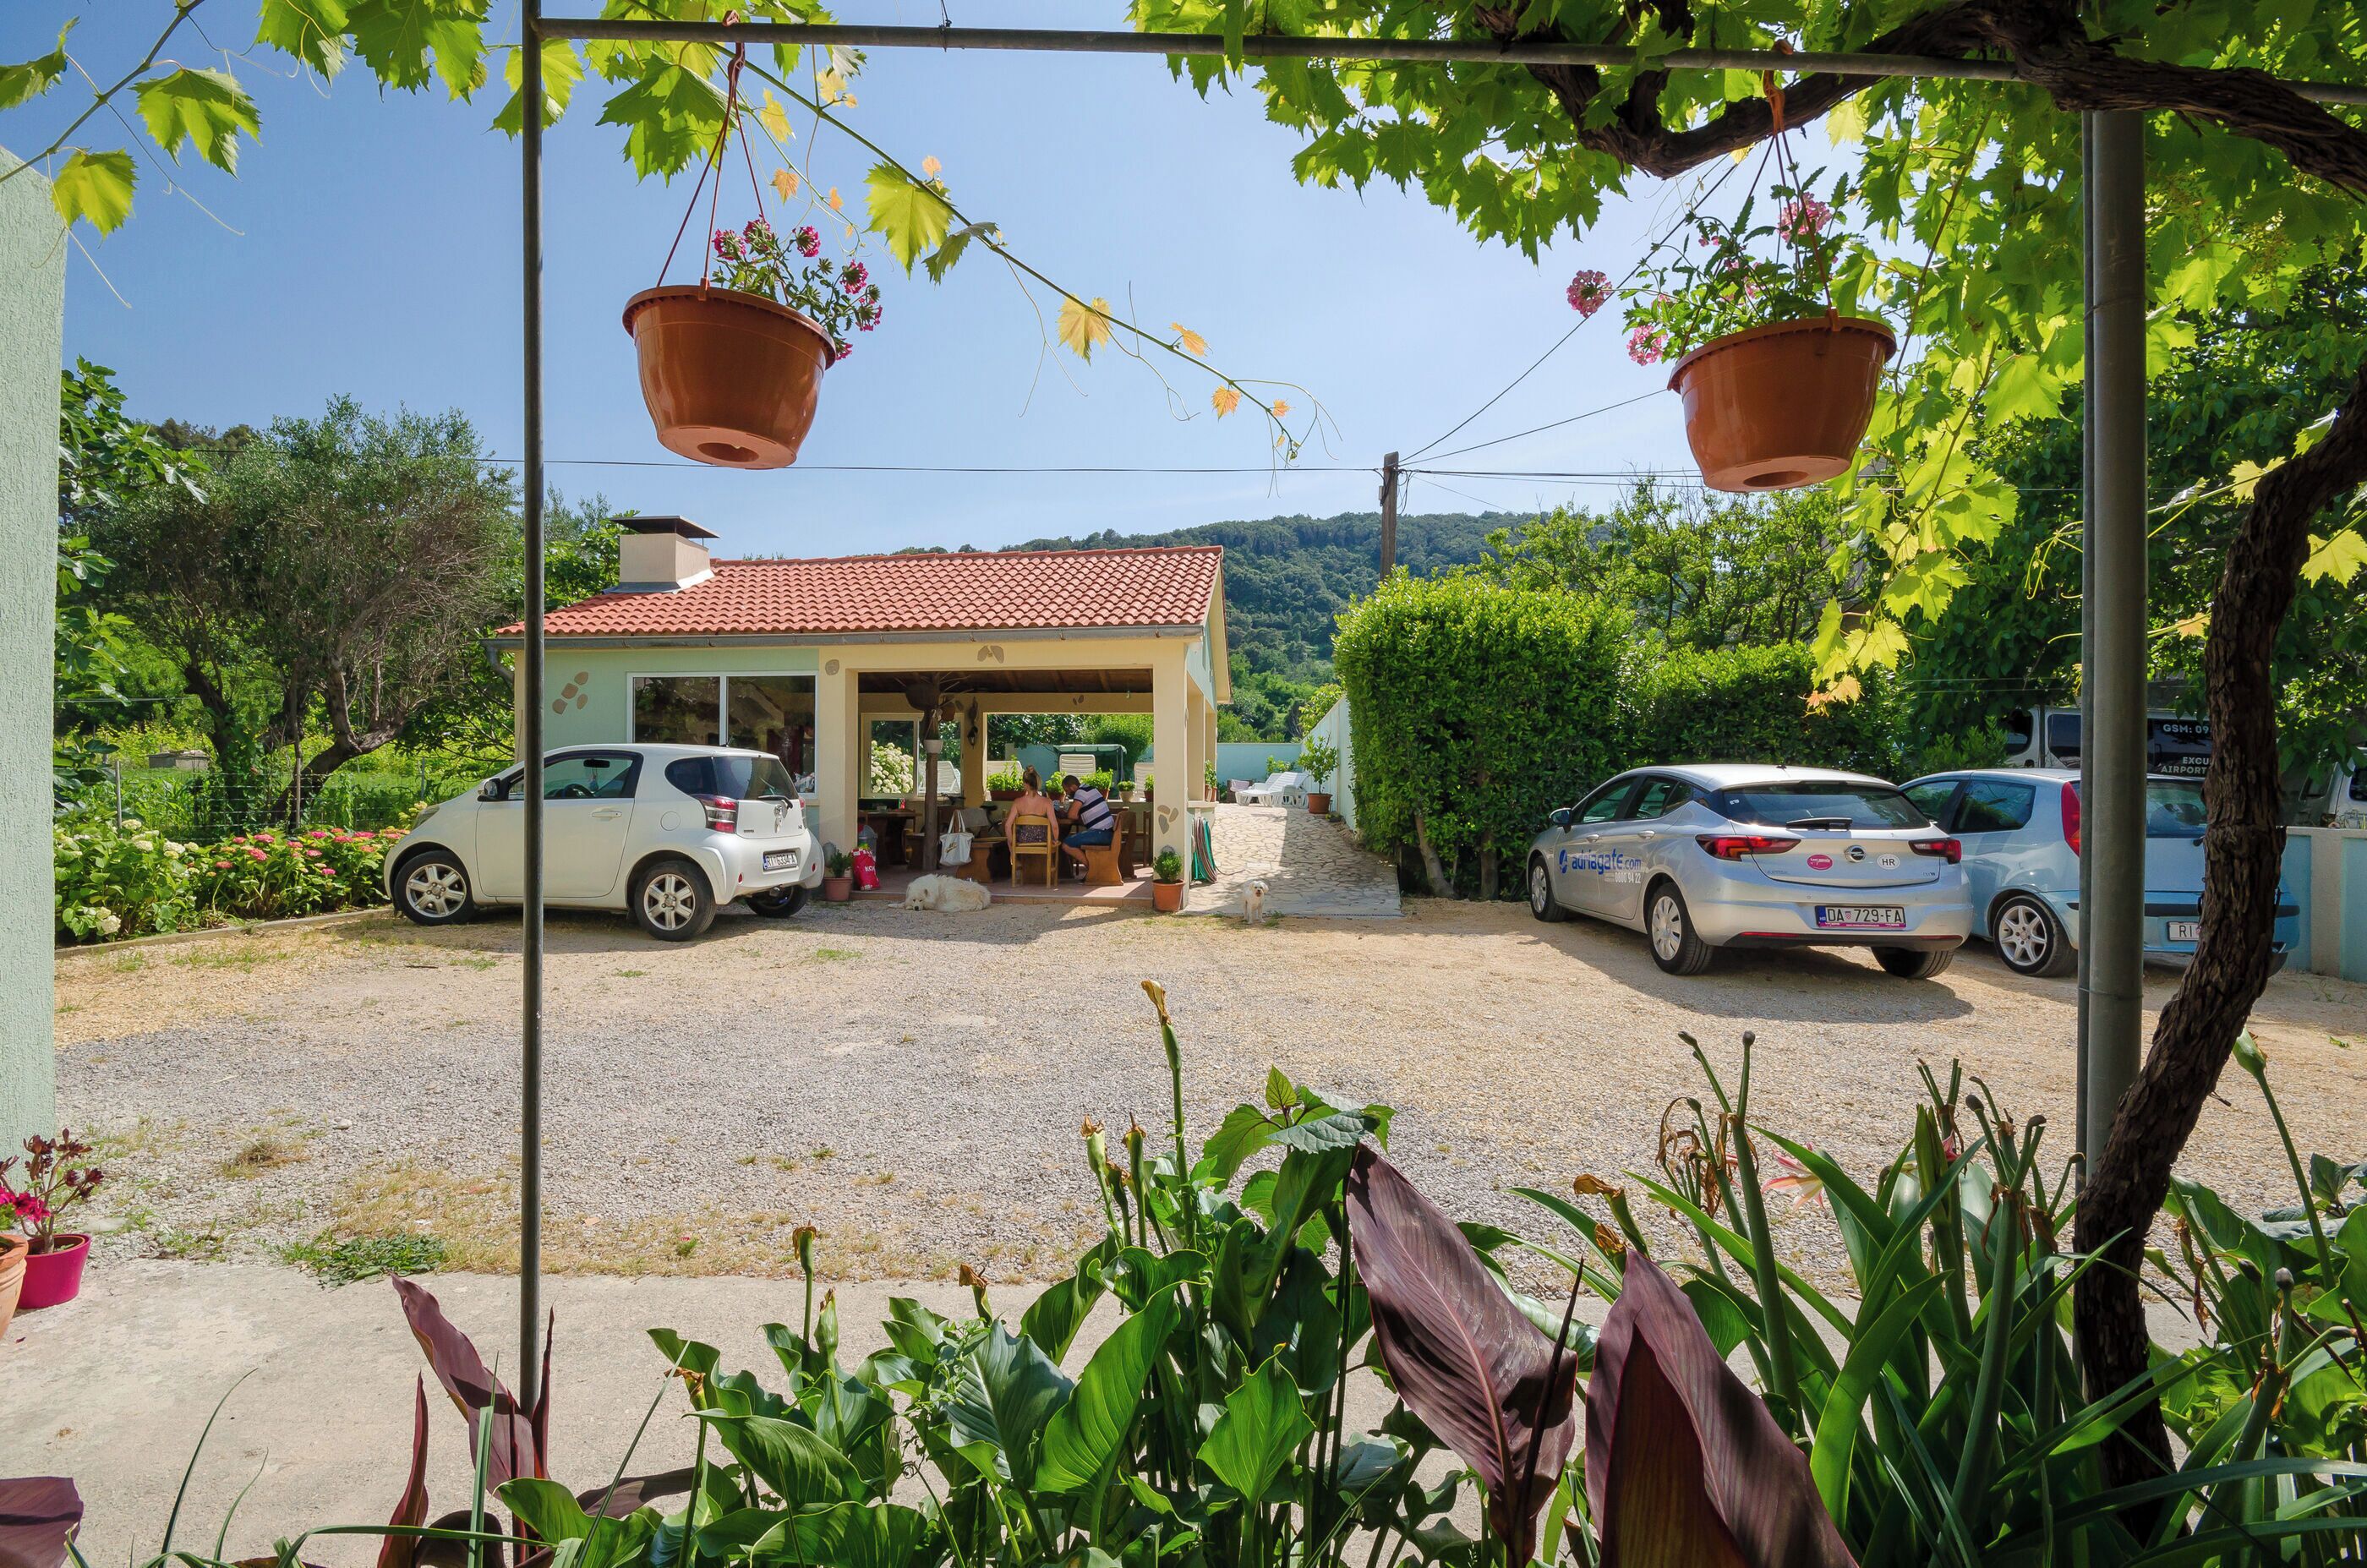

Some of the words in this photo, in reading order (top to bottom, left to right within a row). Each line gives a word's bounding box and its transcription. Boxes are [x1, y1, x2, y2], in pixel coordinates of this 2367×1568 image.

[2162, 724, 2193, 734] GSM:
[2195, 725, 2211, 734] 09
[2182, 757, 2211, 766] EXCU
[2161, 765, 2208, 774] AIRPORT
[1572, 848, 1642, 875] adriagate.com
[1881, 858, 1896, 866] HR
[1827, 909, 1845, 922] DA
[1854, 909, 1903, 923] 729-FA
[2178, 925, 2193, 937] RI
